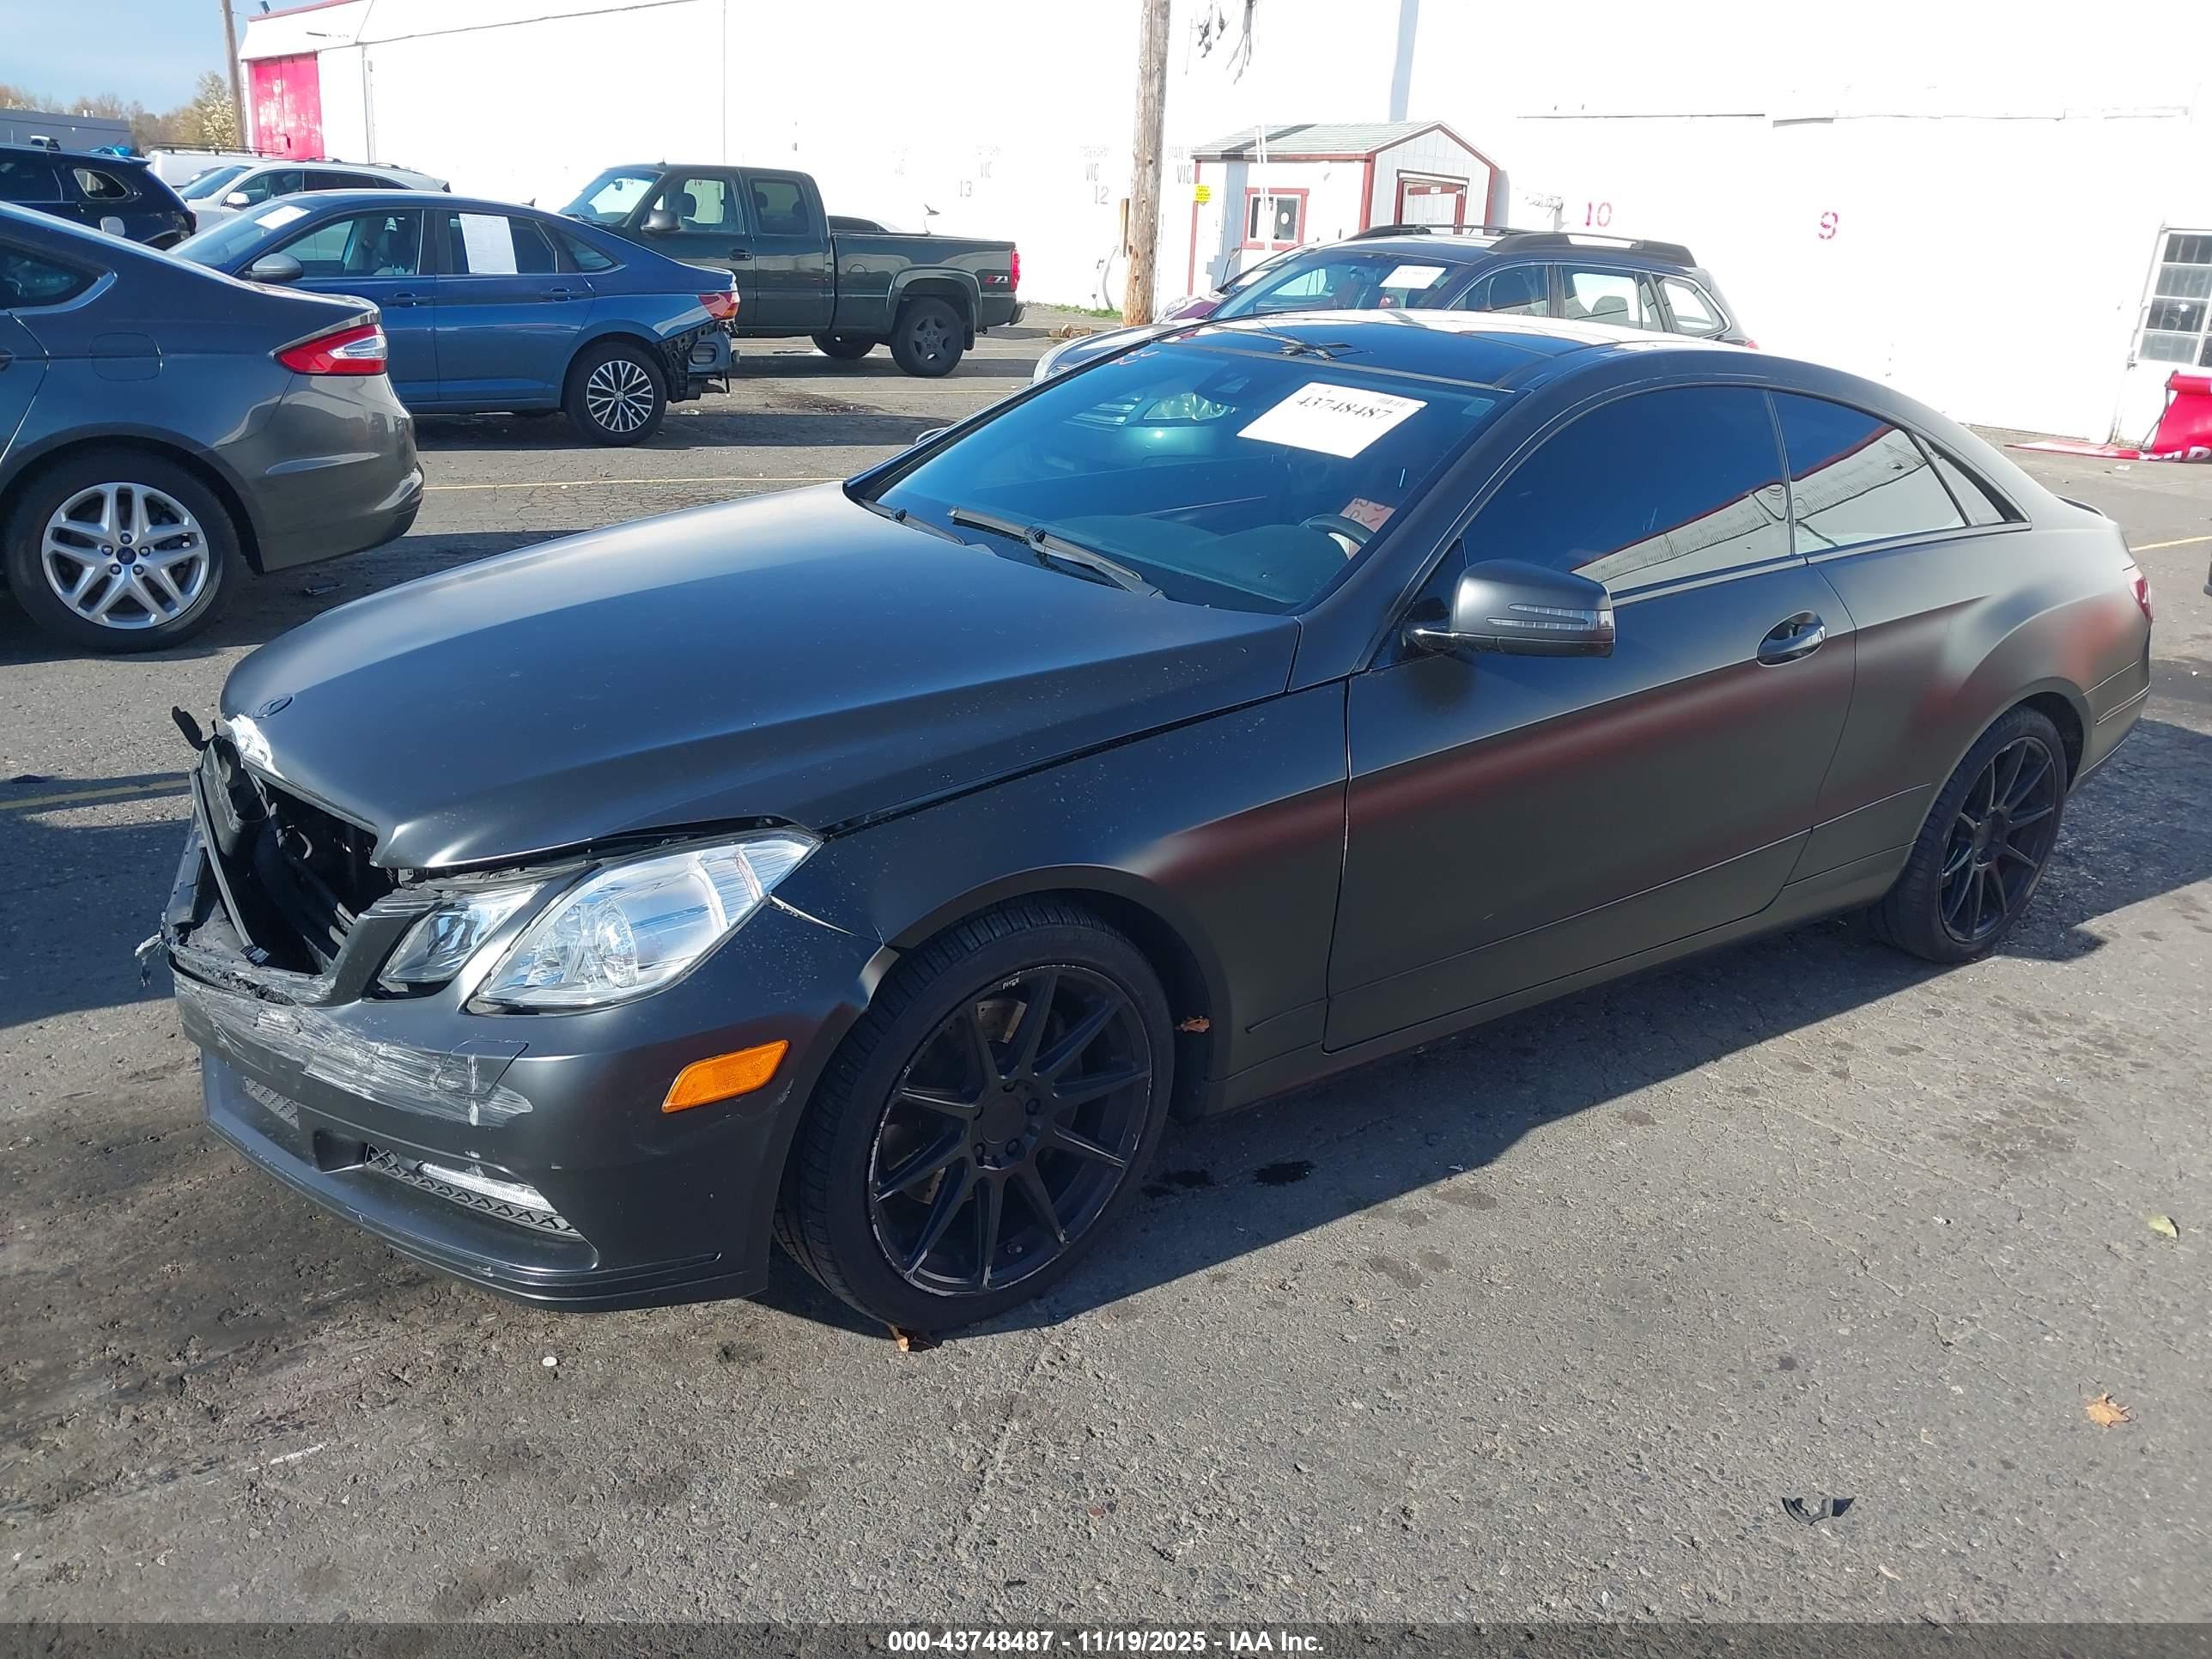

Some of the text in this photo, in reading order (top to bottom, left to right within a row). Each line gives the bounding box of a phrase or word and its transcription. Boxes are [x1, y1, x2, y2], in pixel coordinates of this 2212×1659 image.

[1085, 163, 1099, 182] VIC
[1176, 164, 1193, 185] VIC
[959, 179, 973, 198] 13
[1094, 185, 1109, 205] 12
[1585, 201, 1613, 228] 10
[1818, 211, 1838, 240] 9
[1296, 396, 1394, 420] 43748487
